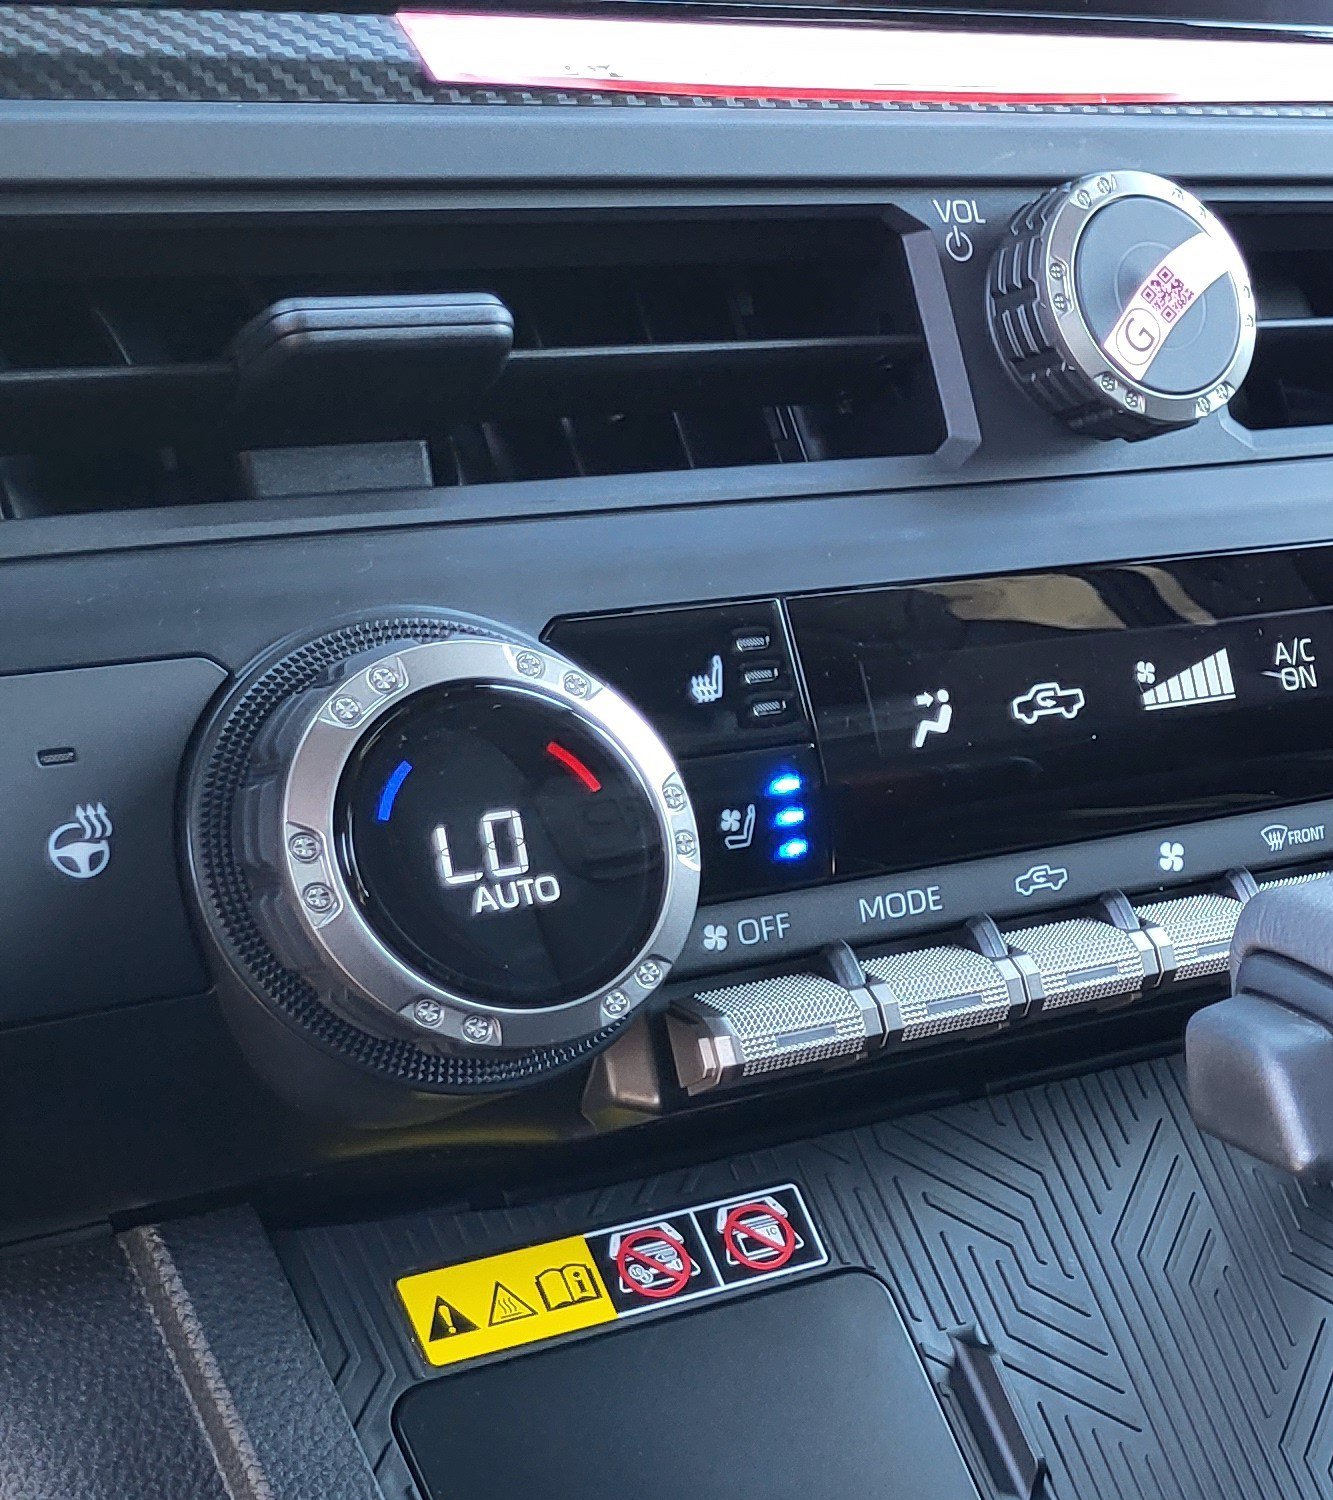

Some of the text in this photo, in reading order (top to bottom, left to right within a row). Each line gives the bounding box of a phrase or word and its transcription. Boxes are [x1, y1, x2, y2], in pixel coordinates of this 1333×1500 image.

[933, 199, 987, 224] VOL
[1124, 316, 1155, 353] G
[1274, 636, 1316, 667] A/C
[1281, 664, 1318, 692] ON
[433, 807, 531, 885] LO
[1286, 823, 1326, 845] FRONT
[473, 873, 562, 915] AUTO
[857, 885, 944, 923] MODE
[736, 912, 792, 946] OFF
